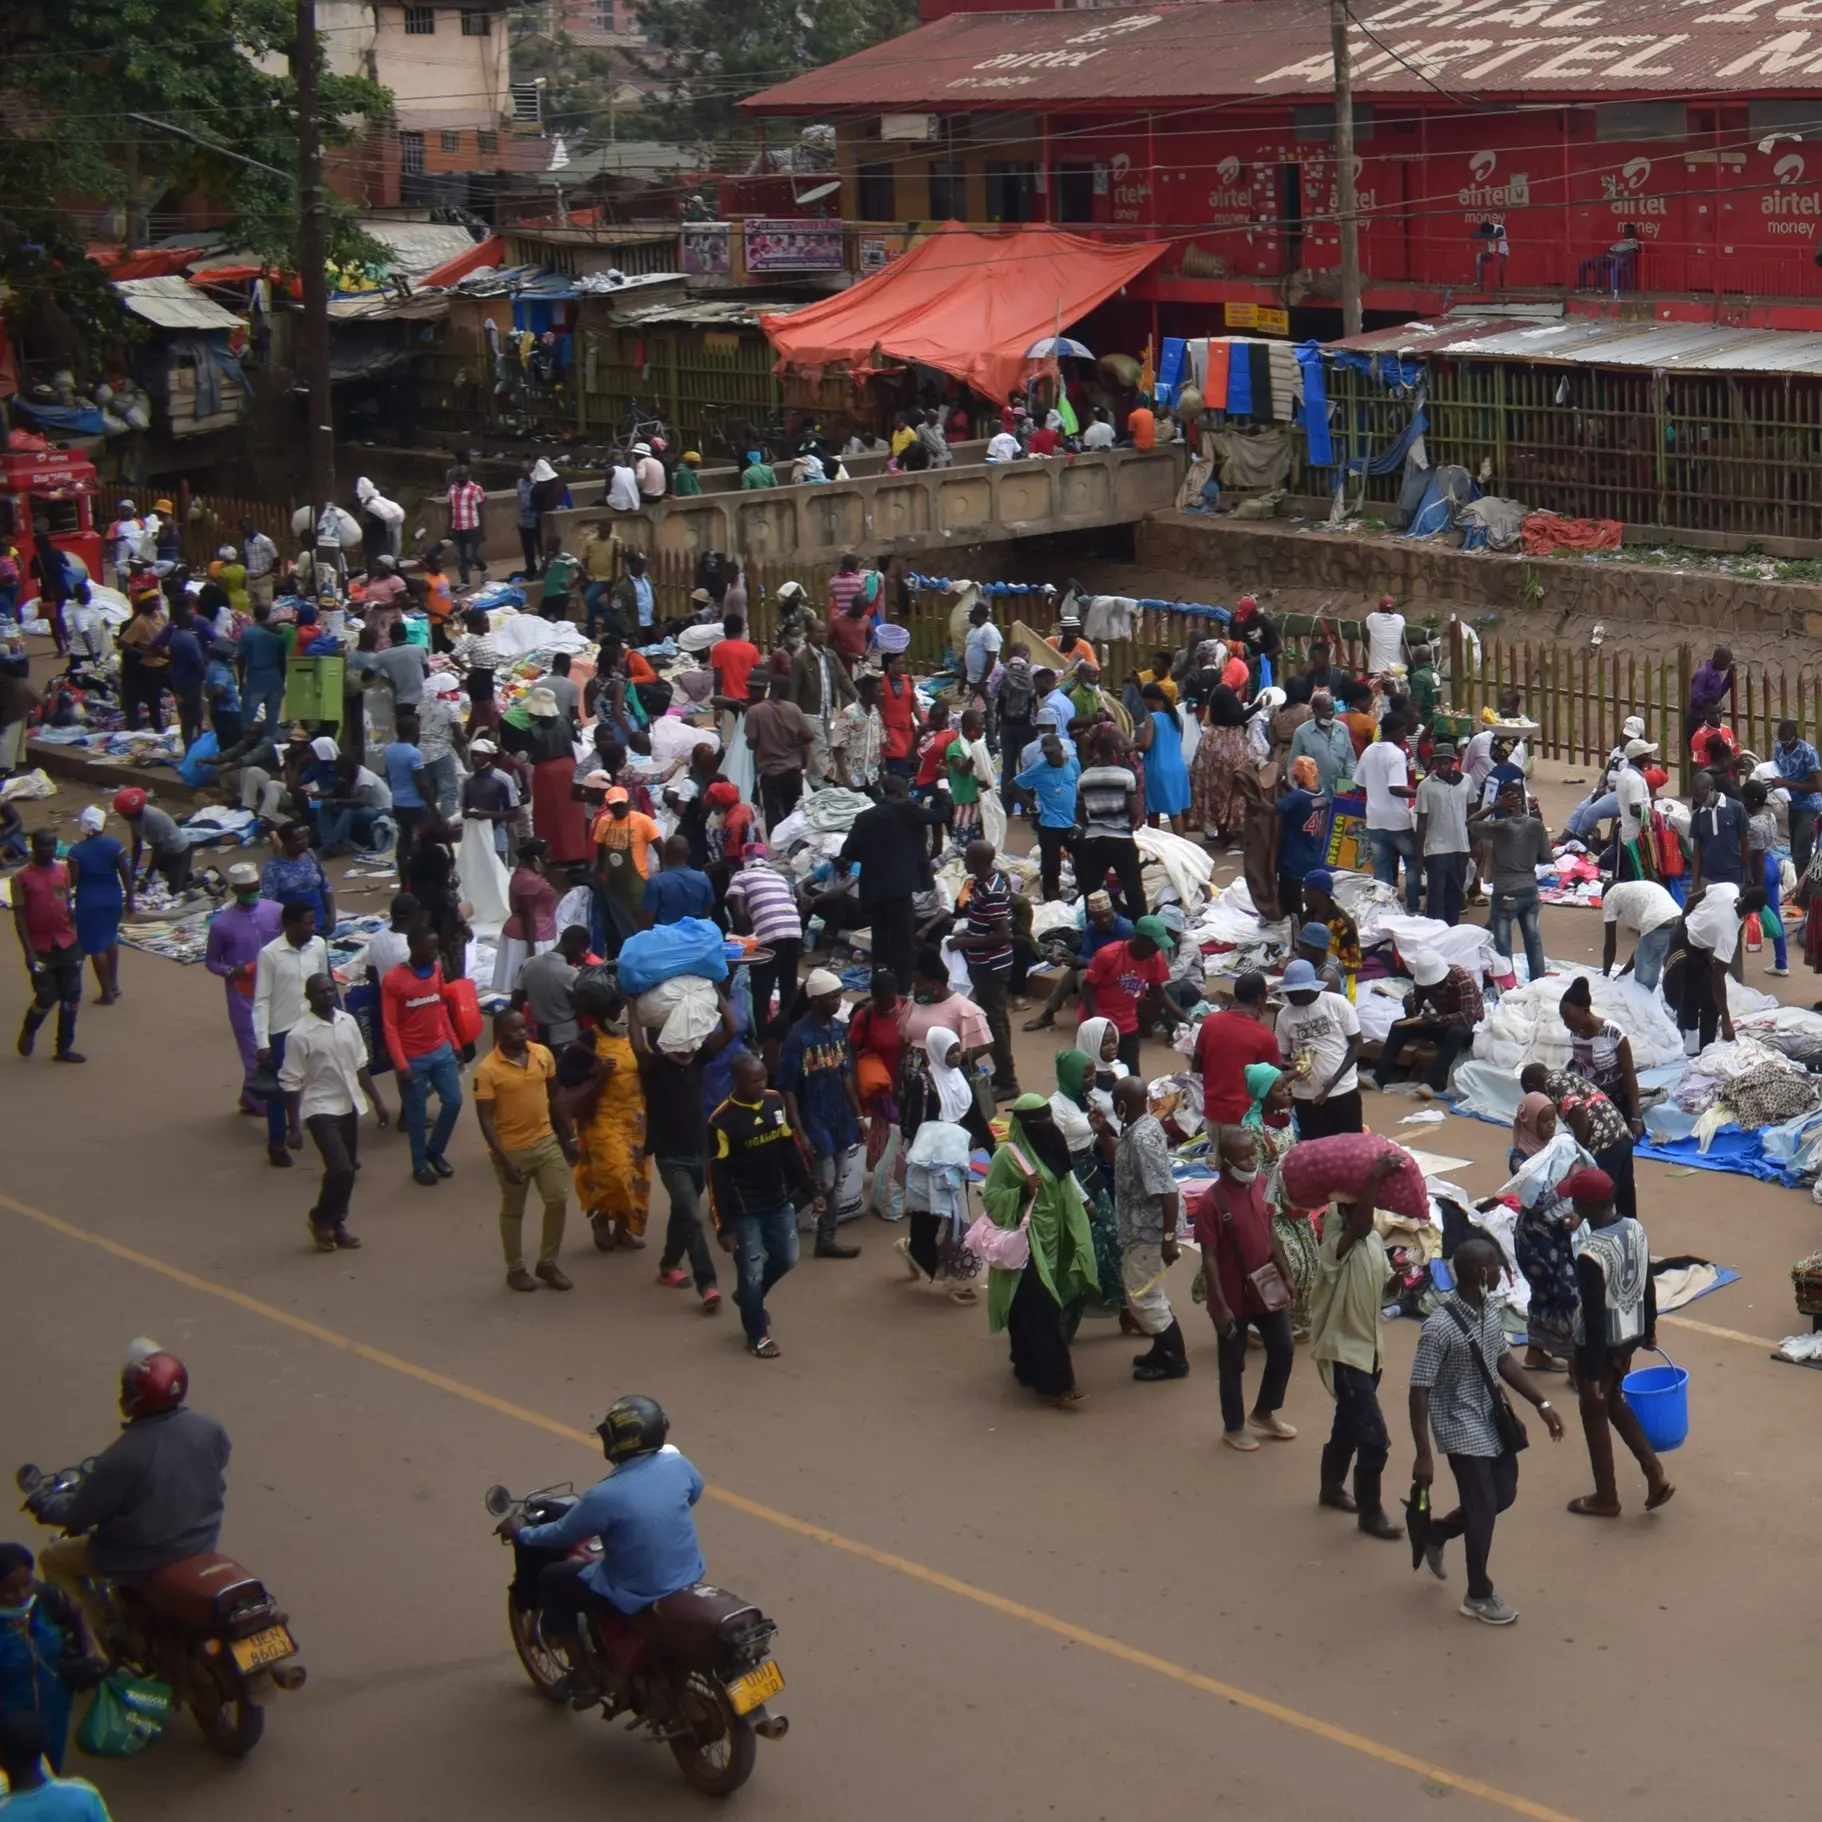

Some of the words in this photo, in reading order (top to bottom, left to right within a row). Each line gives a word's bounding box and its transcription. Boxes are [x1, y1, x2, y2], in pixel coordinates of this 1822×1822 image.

[1347, 0, 1604, 32] DIAL
[1255, 33, 1691, 83] AIRTEL
[1208, 186, 1255, 208] airtel
[1458, 183, 1511, 206] airtel
[1610, 191, 1667, 215] airtel
[1761, 189, 1822, 215] airtel
[1464, 212, 1506, 225] money
[1768, 221, 1815, 239] money
[1326, 815, 1345, 866] AFRICA
